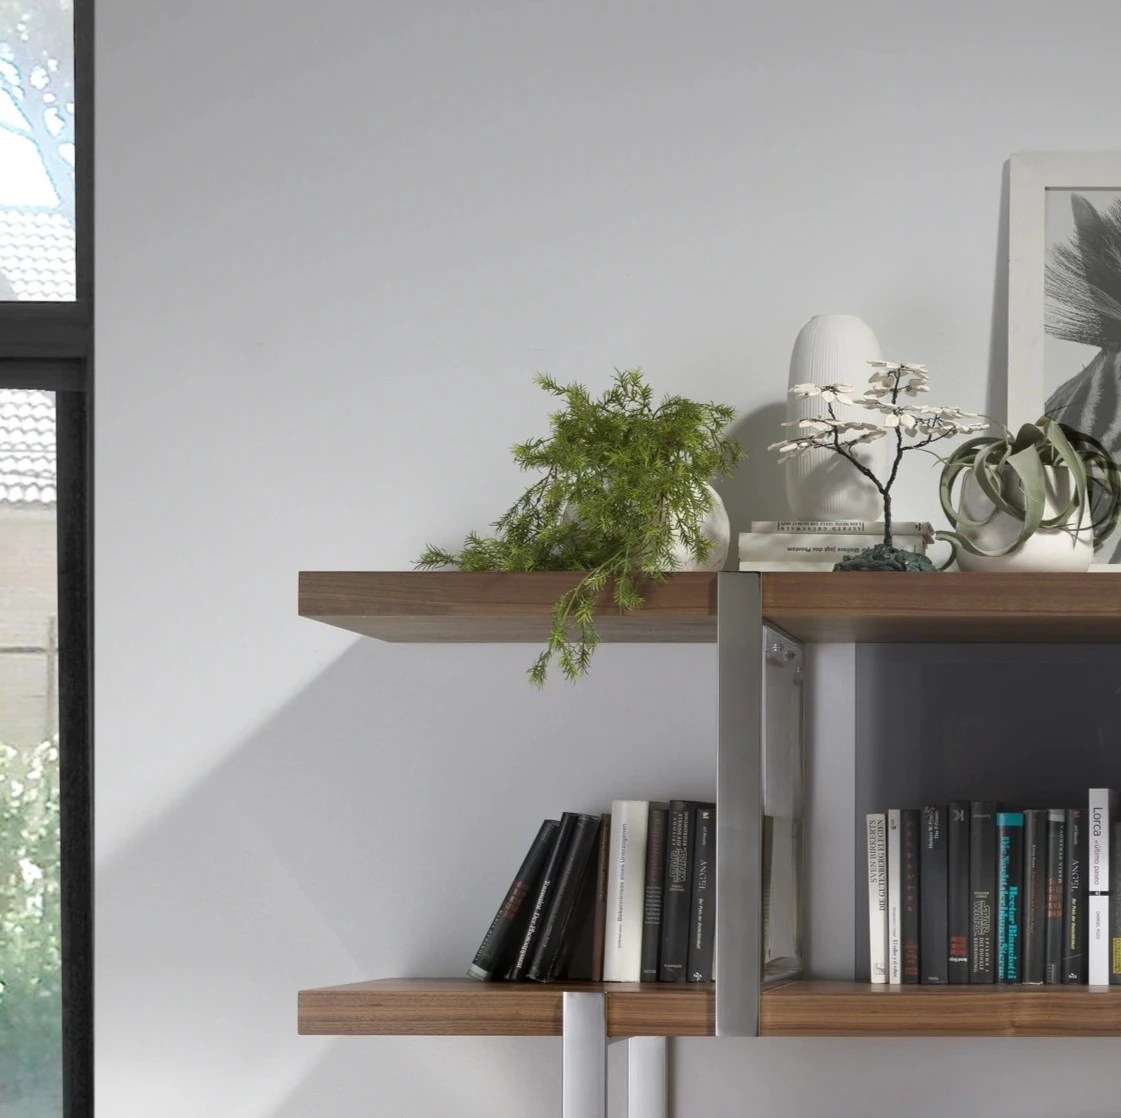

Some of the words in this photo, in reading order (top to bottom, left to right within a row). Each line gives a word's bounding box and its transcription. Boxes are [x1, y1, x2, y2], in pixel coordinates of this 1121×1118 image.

[1093, 808, 1103, 836] Lorca
[1000, 836, 1010, 854] Die
[677, 847, 686, 882] WARS
[698, 860, 707, 892] ANGEL
[1000, 856, 1009, 885] Nacht
[1000, 887, 1008, 900] der
[1009, 887, 1018, 924] Hector
[531, 912, 540, 924] Der
[974, 901, 982, 936] WARS
[981, 901, 990, 934] STAR
[516, 925, 538, 969] Photoapparat
[999, 943, 1007, 978] Sterne
[1008, 925, 1017, 979] Bianciotti
